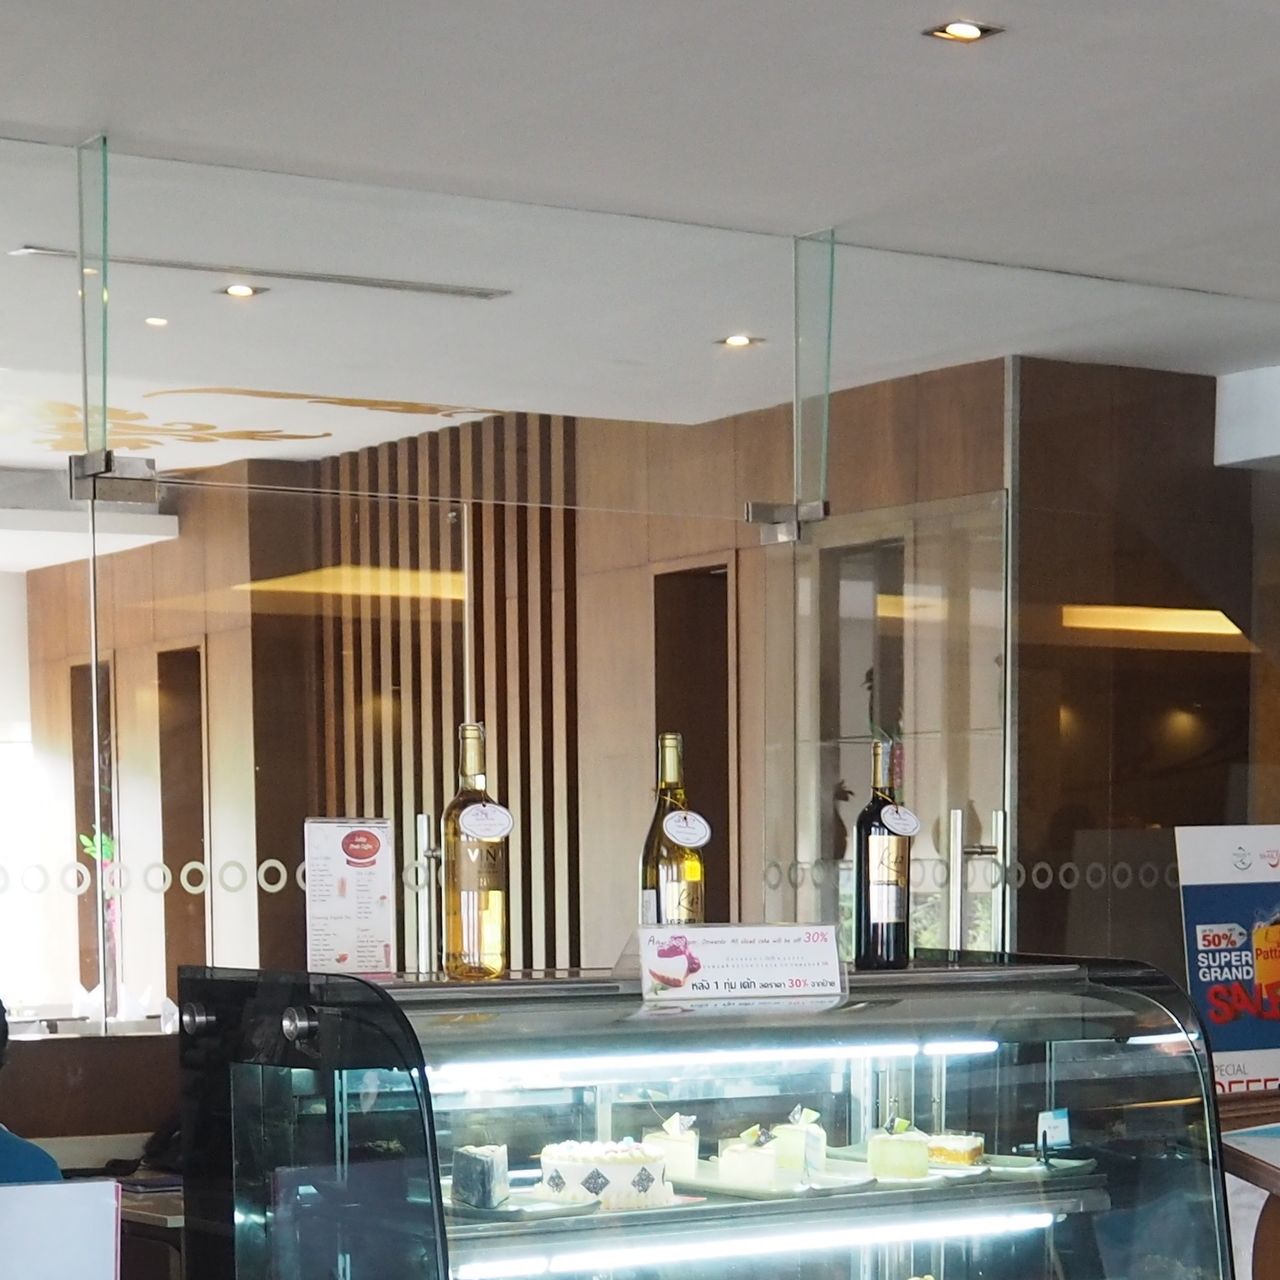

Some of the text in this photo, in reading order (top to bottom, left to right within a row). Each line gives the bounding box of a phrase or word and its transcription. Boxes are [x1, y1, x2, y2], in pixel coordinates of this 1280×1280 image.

[804, 931, 828, 943] 30%
[1202, 933, 1237, 948] 50%
[1198, 951, 1253, 967] SUPER
[1198, 966, 1254, 982] GRAND
[713, 981, 719, 990] 1
[787, 978, 809, 988] 30%
[1215, 1064, 1248, 1077] PECIAL
